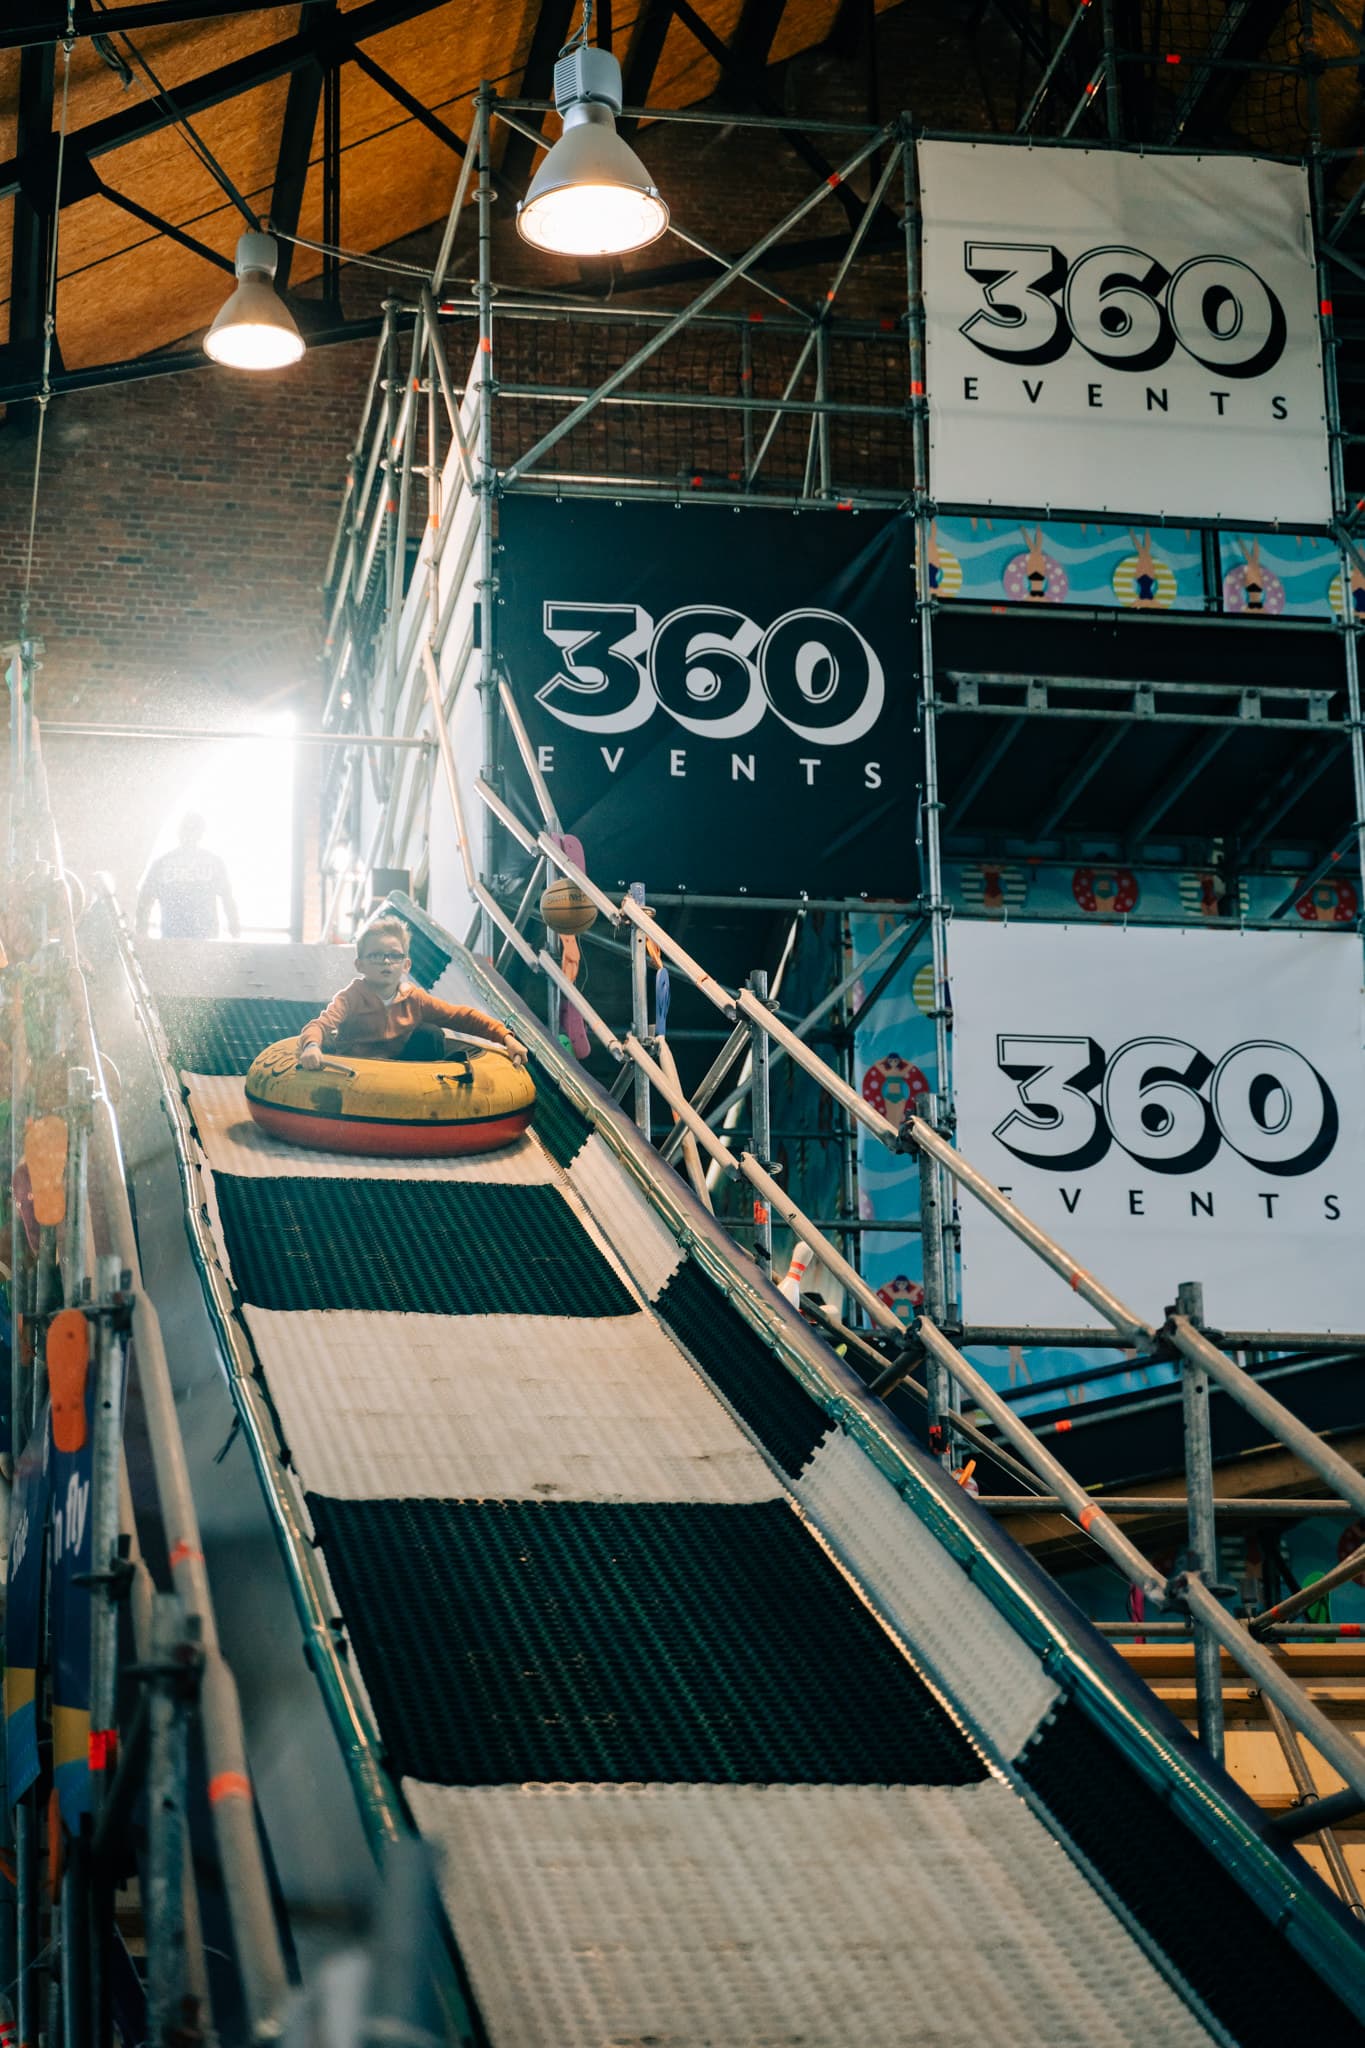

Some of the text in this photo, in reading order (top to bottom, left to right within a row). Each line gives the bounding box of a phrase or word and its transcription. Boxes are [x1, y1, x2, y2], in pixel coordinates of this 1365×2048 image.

[958, 241, 1287, 379] 360
[964, 377, 1288, 420] EVENTS
[534, 600, 886, 746] 360
[537, 746, 882, 789] EVENTS
[992, 1033, 1339, 1177] 360
